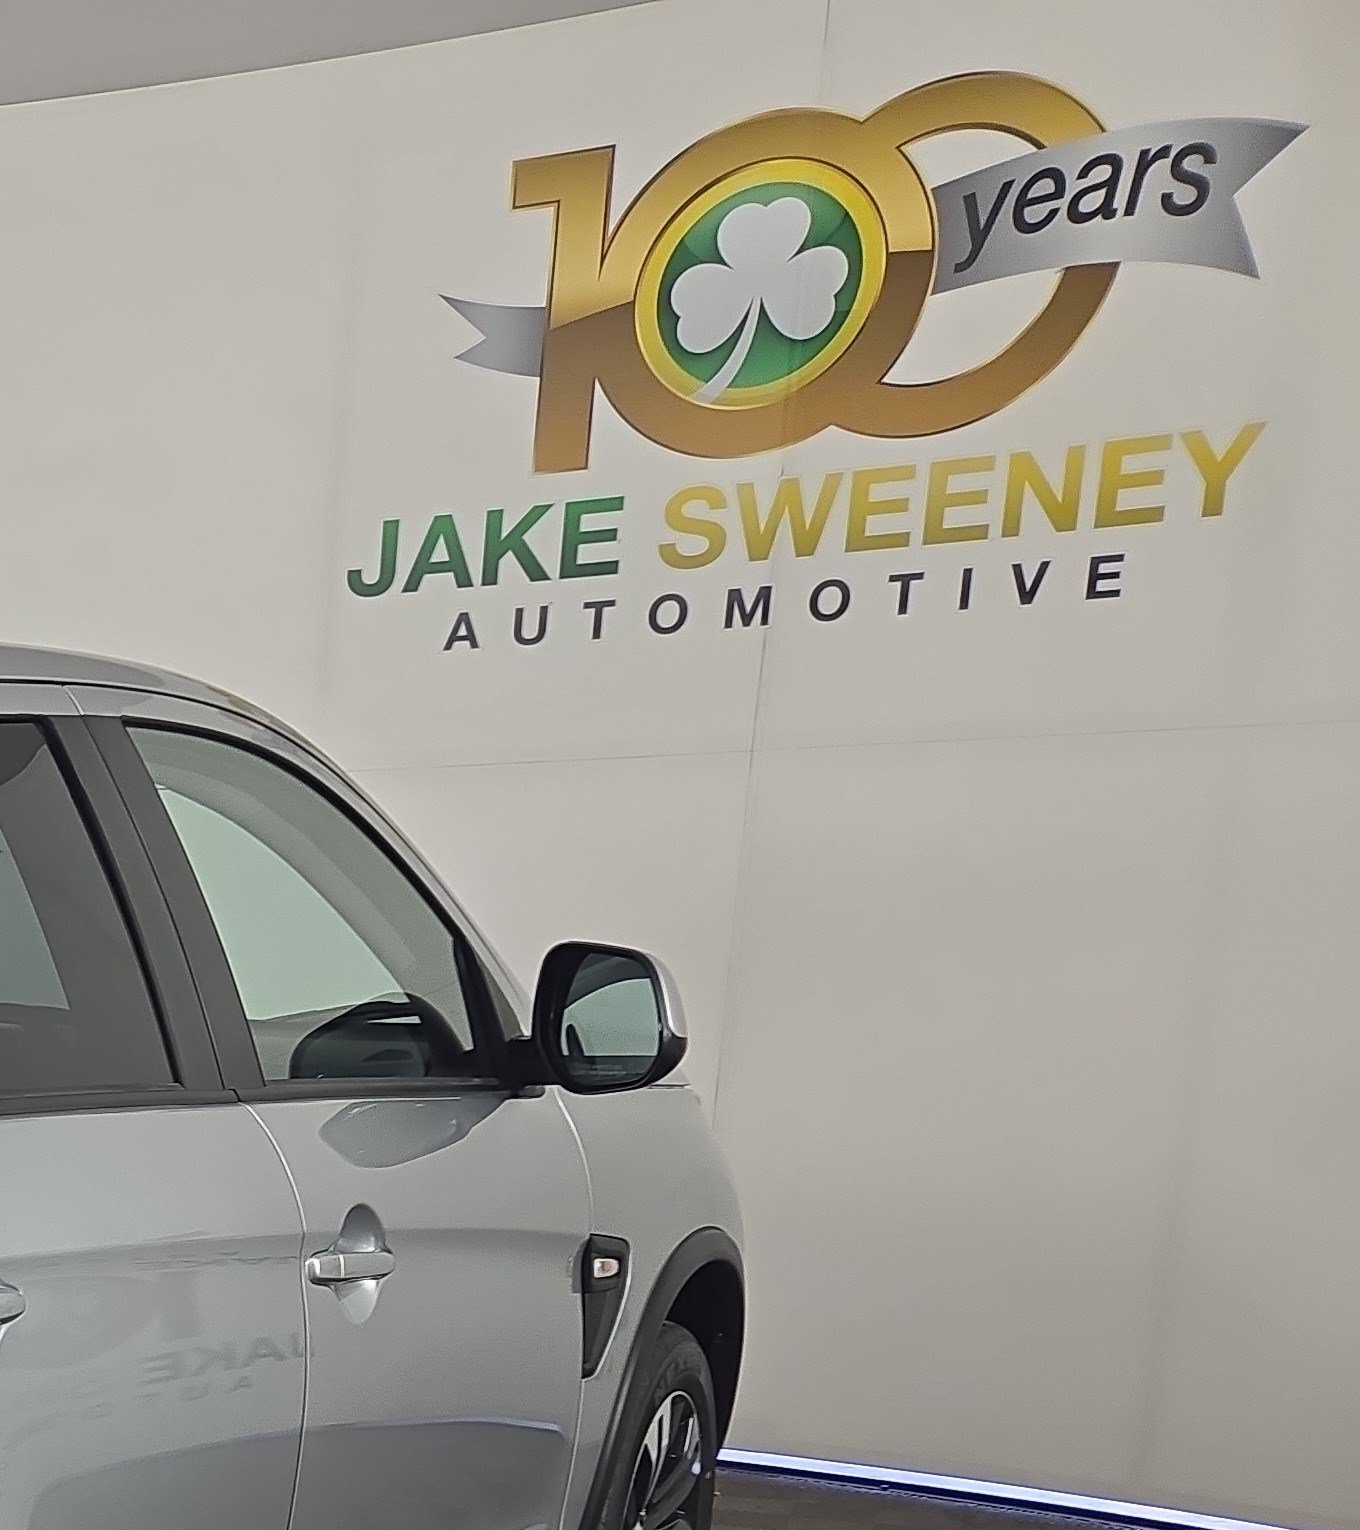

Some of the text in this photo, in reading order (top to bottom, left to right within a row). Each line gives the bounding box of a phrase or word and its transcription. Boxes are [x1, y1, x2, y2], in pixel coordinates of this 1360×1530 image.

[951, 140, 1217, 274] years
[347, 420, 1268, 597] JAKE SWEENEY
[443, 552, 1125, 651] AUTOMOTIVE
